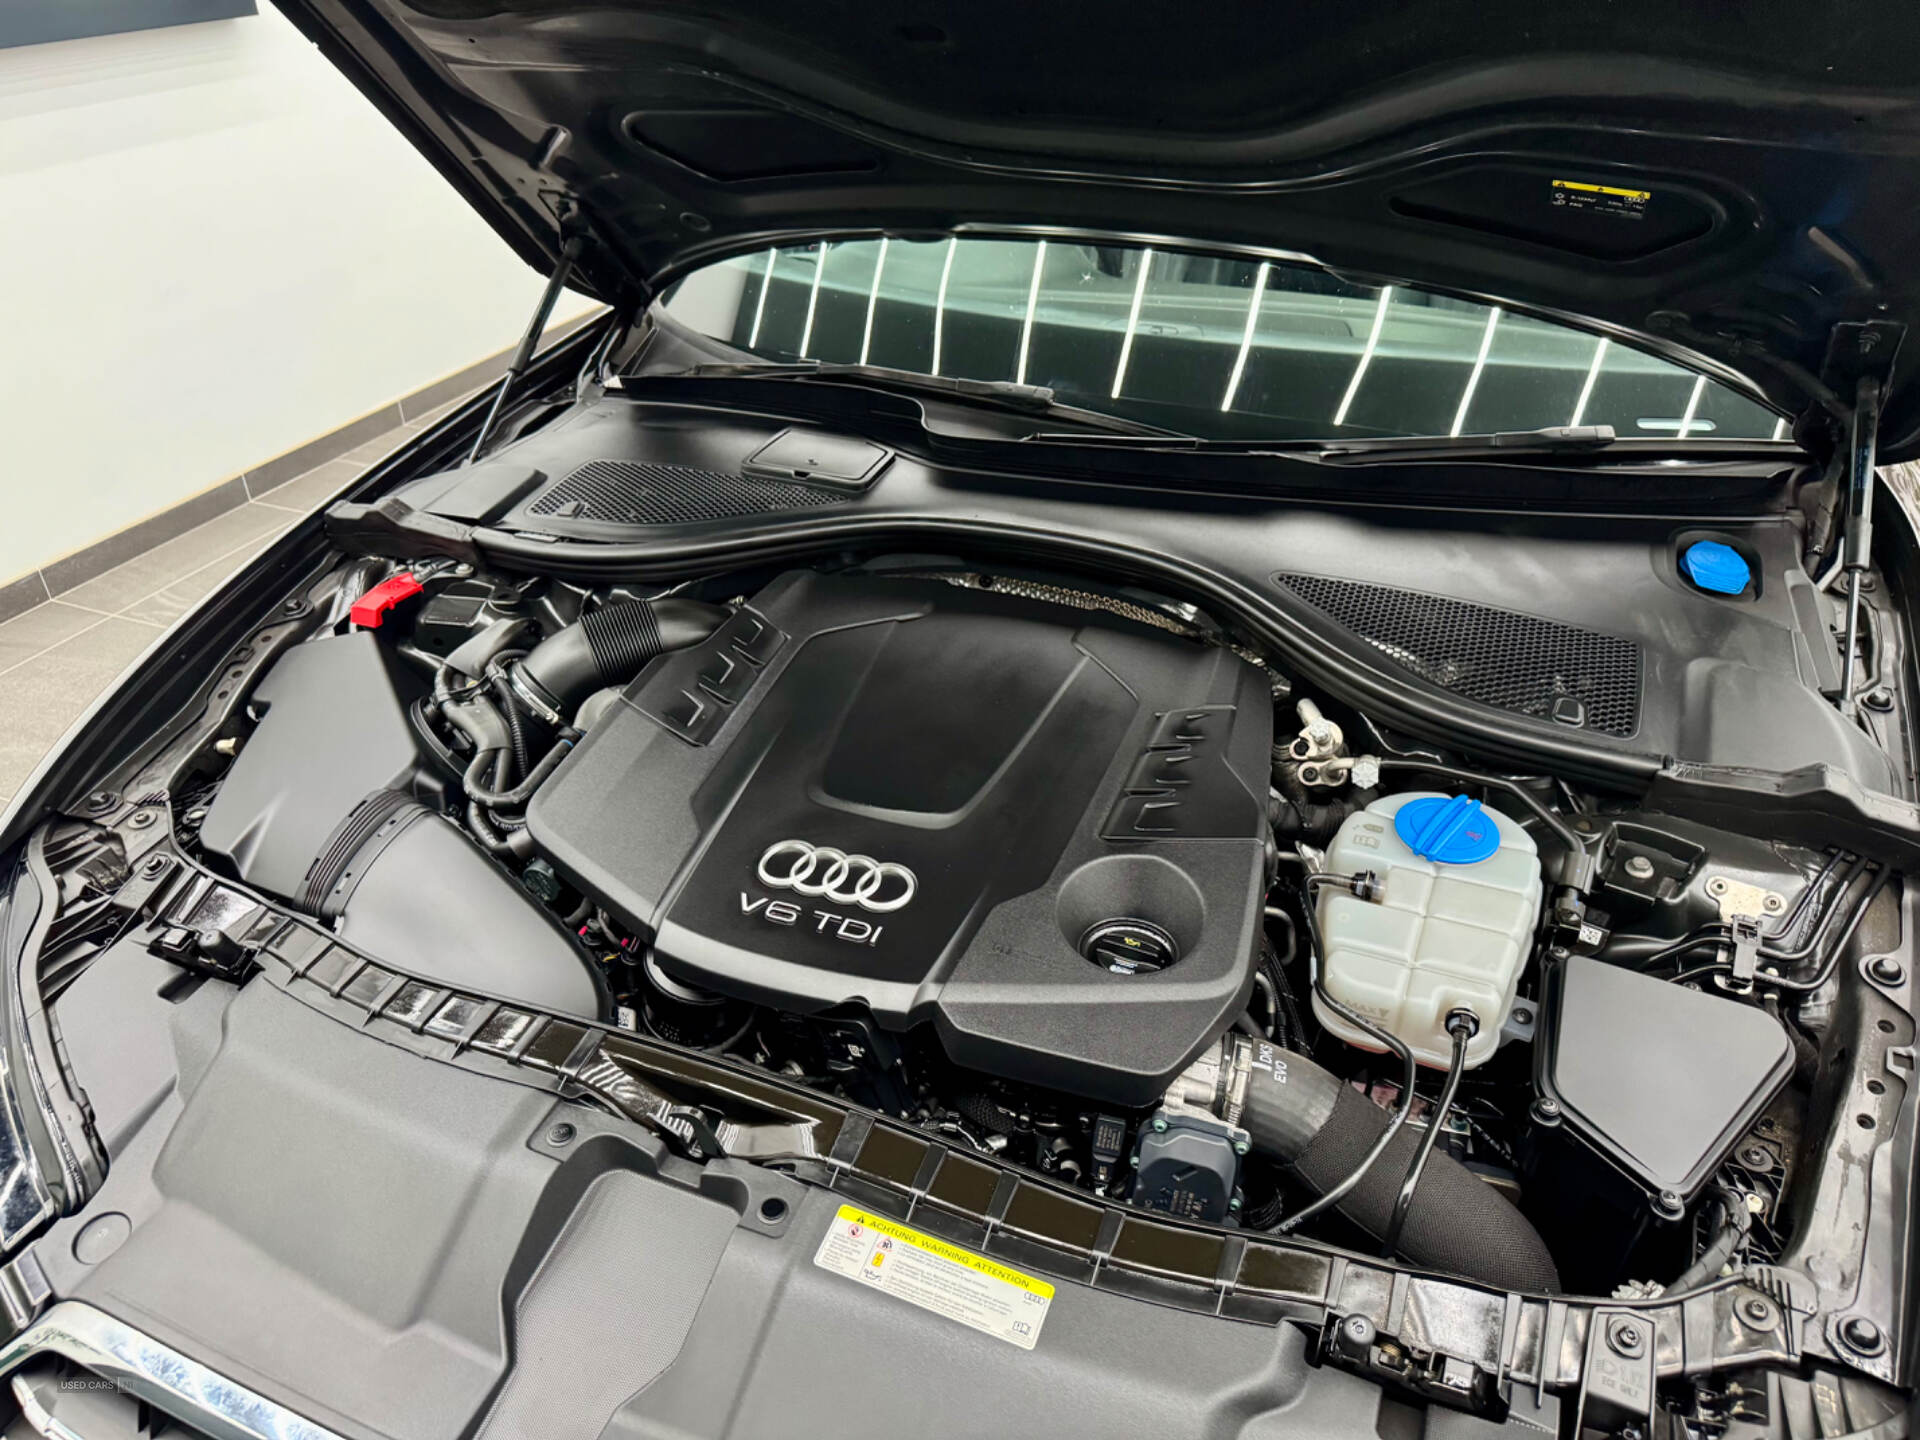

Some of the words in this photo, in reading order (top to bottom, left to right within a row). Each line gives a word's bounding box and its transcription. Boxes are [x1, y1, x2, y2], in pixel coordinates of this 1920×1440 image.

[741, 892, 802, 925] V6
[813, 910, 883, 946] TDI
[1274, 1060, 1288, 1084] EVO
[869, 1220, 917, 1244] ACHTUNG
[921, 1240, 970, 1264] WARNING
[973, 1260, 1030, 1289] ATTENTION
